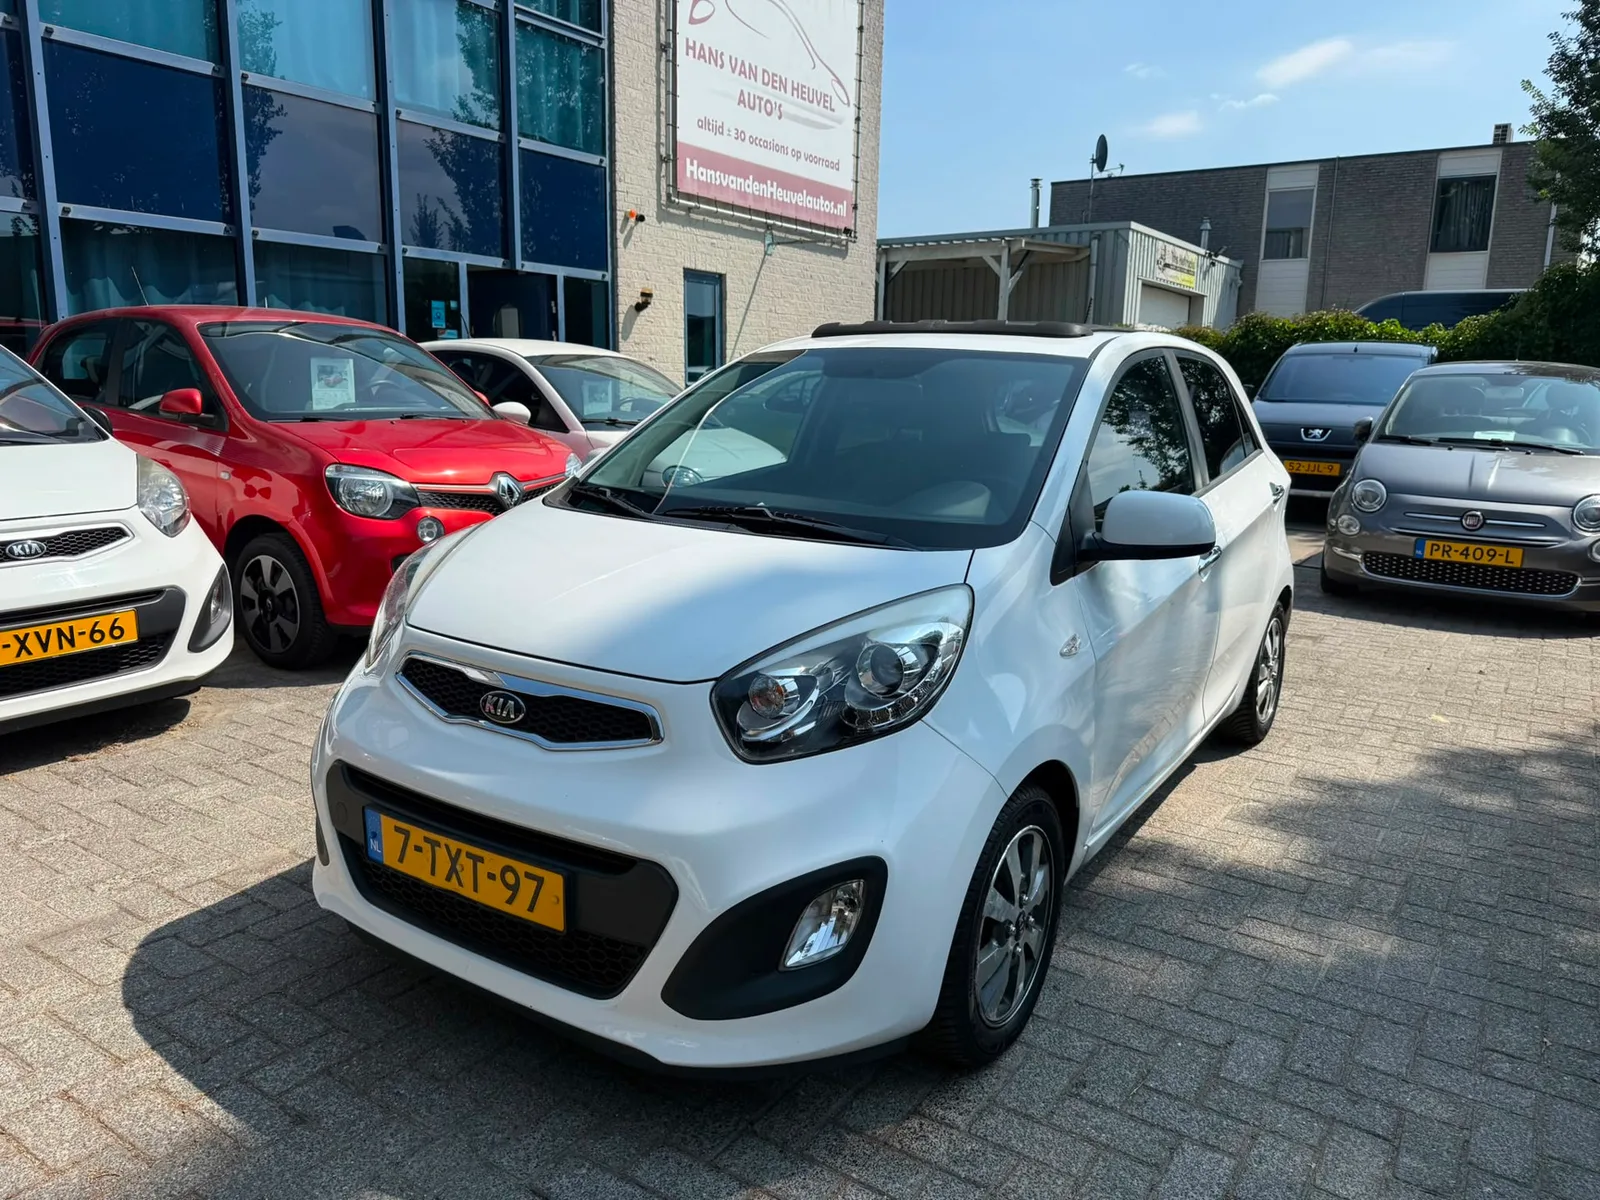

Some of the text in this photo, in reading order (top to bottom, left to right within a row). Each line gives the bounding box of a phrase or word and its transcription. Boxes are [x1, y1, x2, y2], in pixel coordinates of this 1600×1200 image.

[685, 37, 836, 112] HANS VAN DEN HEUVEL
[737, 89, 783, 120] AUTO'S
[697, 116, 725, 136] altijd
[734, 128, 746, 143] 30
[748, 135, 789, 156] occasions
[791, 148, 802, 161] op
[803, 151, 840, 171] voorraad
[685, 157, 847, 217] HansvandenHeuvelautos.nl
[12, 543, 42, 556] KIA
[1429, 542, 1514, 565] PR-409-L
[484, 694, 515, 719] KIA
[370, 825, 545, 913] NL 7-TXT-97
